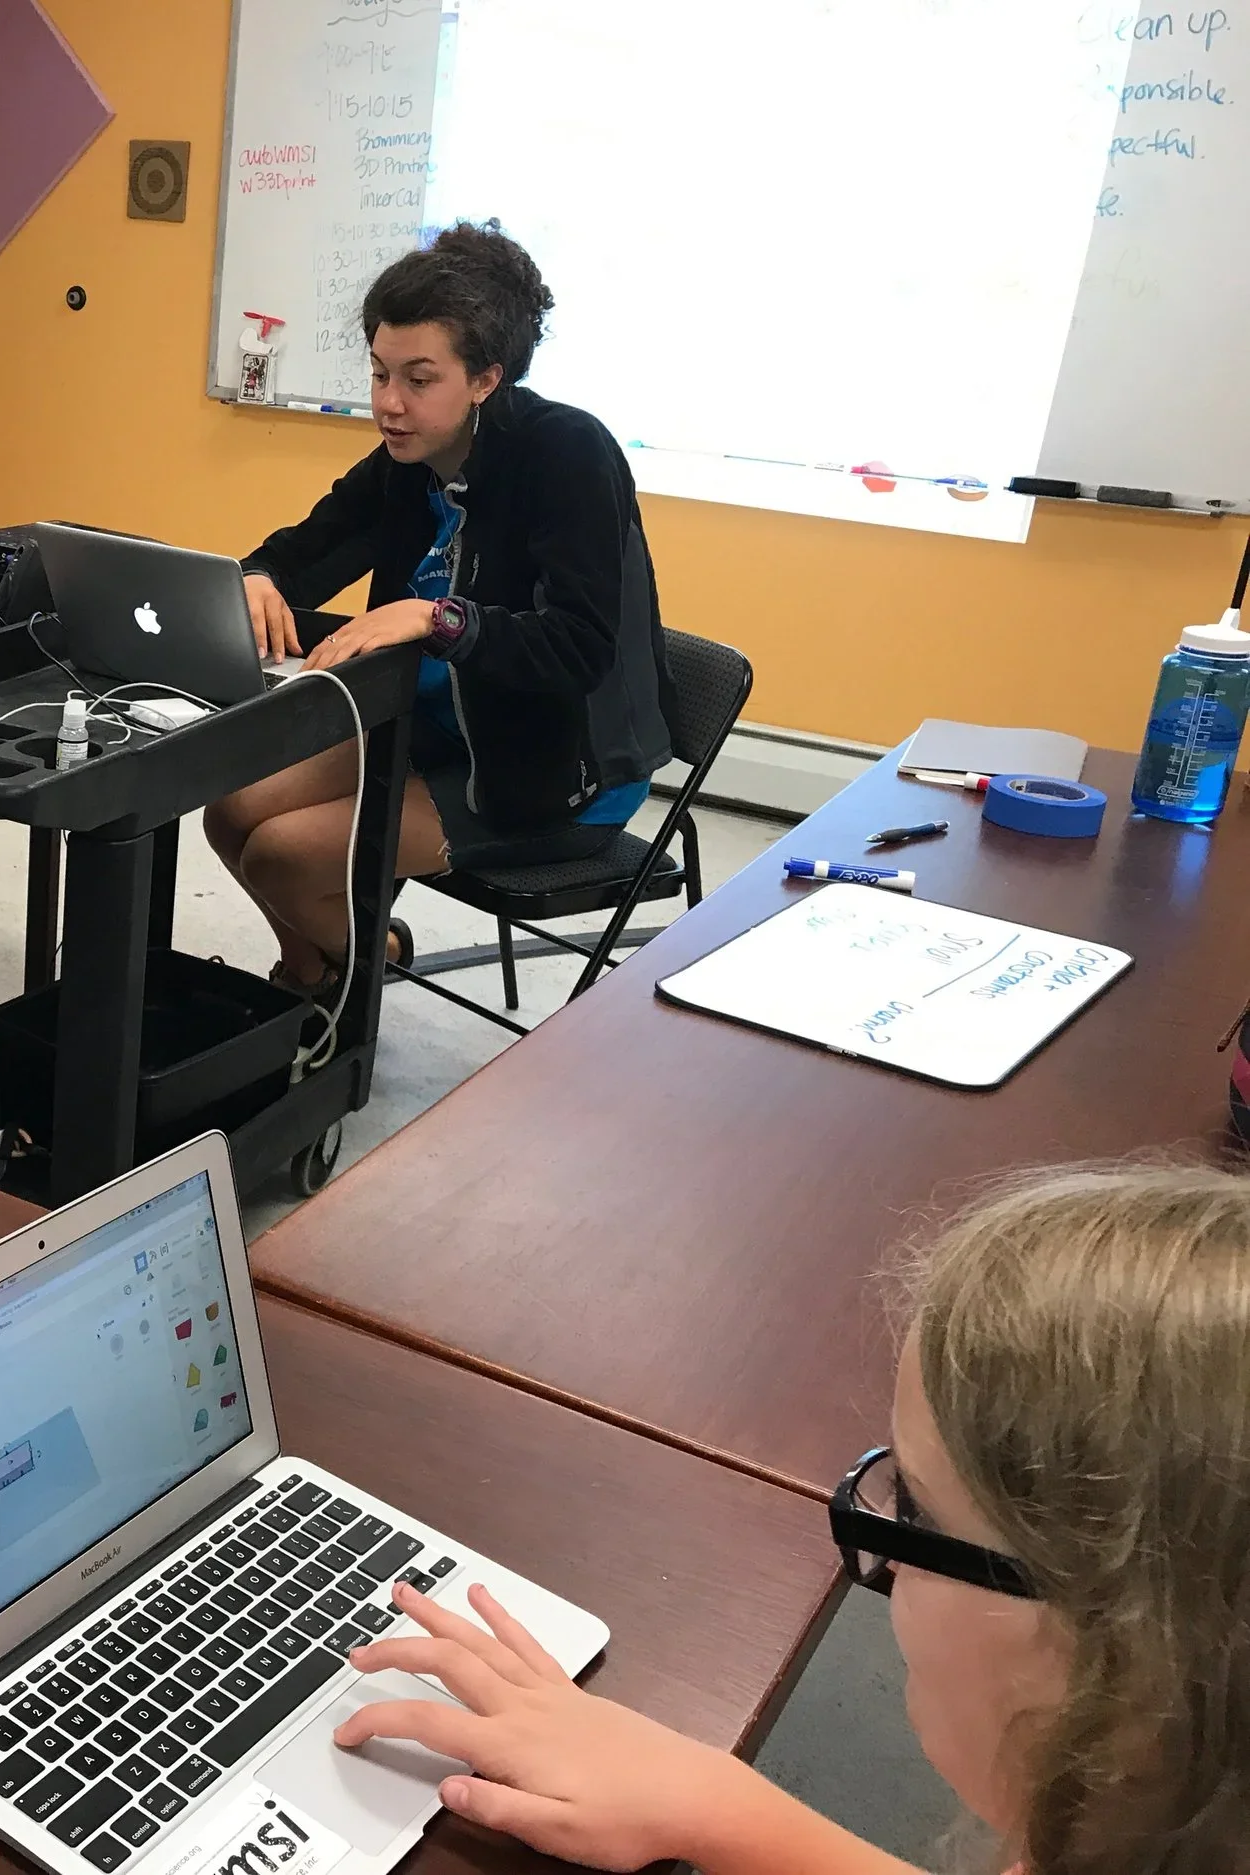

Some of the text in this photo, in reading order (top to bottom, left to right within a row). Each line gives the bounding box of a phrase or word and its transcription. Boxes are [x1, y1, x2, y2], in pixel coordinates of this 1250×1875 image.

[837, 869, 880, 886] EXPO
[80, 1552, 113, 1580] MacBook
[249, 1576, 261, 1585] O
[202, 1613, 213, 1622] U
[263, 1608, 275, 1617] K
[177, 1632, 189, 1641] Y
[283, 1637, 297, 1648] M
[152, 1652, 163, 1661] T
[215, 1646, 228, 1657] H
[259, 1657, 272, 1667] N
[88, 1665, 98, 1675] 4
[190, 1667, 202, 1677] G
[126, 1672, 138, 1683] R
[235, 1678, 247, 1688] B
[60, 1687, 71, 1696] 3
[165, 1688, 175, 1698] F
[100, 1694, 111, 1704] E
[209, 1698, 222, 1708] V
[32, 1708, 43, 1718] 2
[138, 1710, 150, 1720] D
[70, 1713, 85, 1726] W
[185, 1720, 197, 1731] C
[111, 1731, 123, 1742] S
[43, 1737, 57, 1748] Q
[157, 1743, 170, 1753] X
[83, 1755, 96, 1767] A
[129, 1765, 143, 1778] Z
[187, 1766, 215, 1791] command
[35, 1791, 62, 1815] caps lock
[159, 1796, 179, 1815] option
[69, 1825, 84, 1839] shift
[131, 1822, 152, 1841] control
